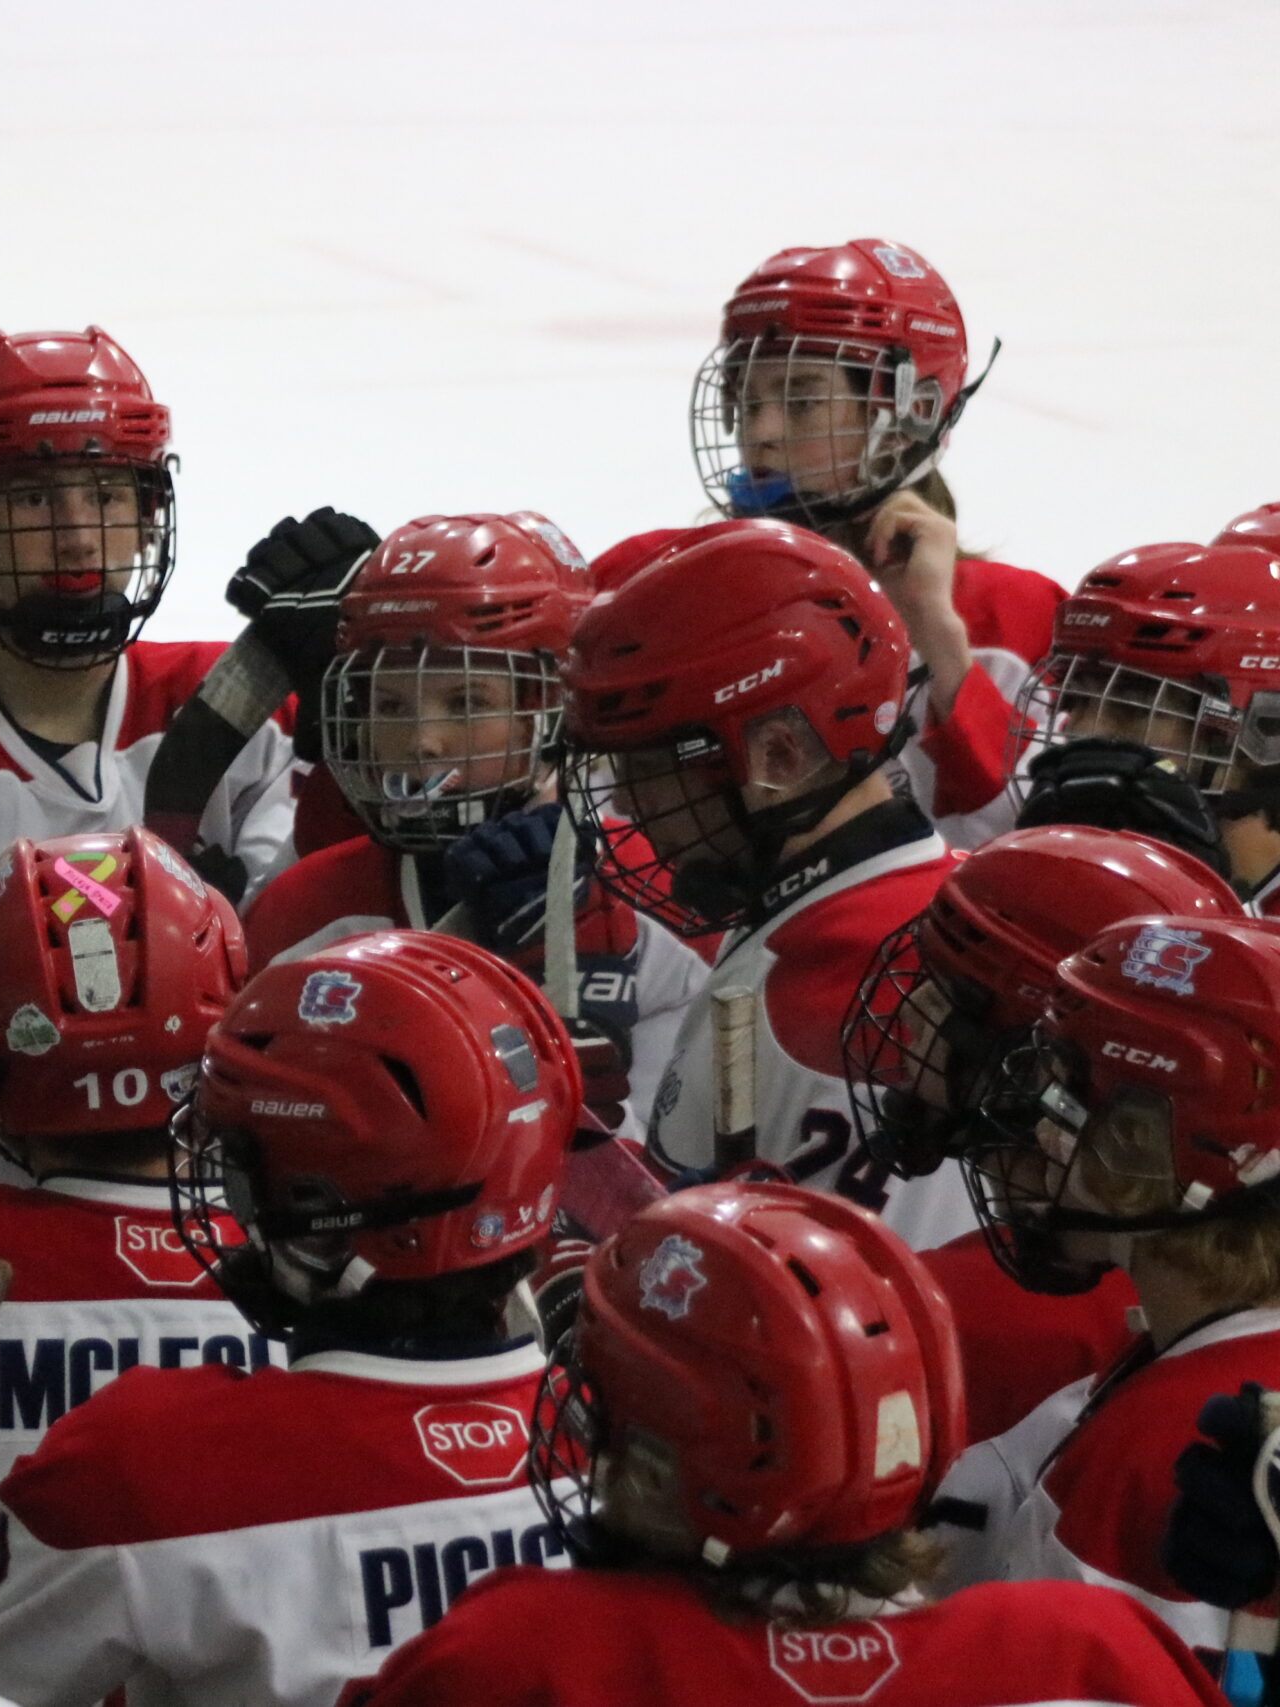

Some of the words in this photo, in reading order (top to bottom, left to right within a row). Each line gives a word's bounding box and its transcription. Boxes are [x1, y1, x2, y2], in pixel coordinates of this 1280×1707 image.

[909, 320, 956, 336] BAUER
[29, 409, 106, 425] BAUER
[390, 550, 436, 575] 27
[1064, 612, 1111, 627] CCM
[41, 628, 111, 644] CCM
[1239, 655, 1280, 670] CC
[714, 659, 786, 704] CCM
[762, 858, 829, 905] CCM
[1100, 1040, 1178, 1073] CCM
[73, 1068, 148, 1110] 10
[250, 1098, 326, 1118] BAUER
[425, 1420, 515, 1453] STOP
[781, 1629, 882, 1664] STOP
